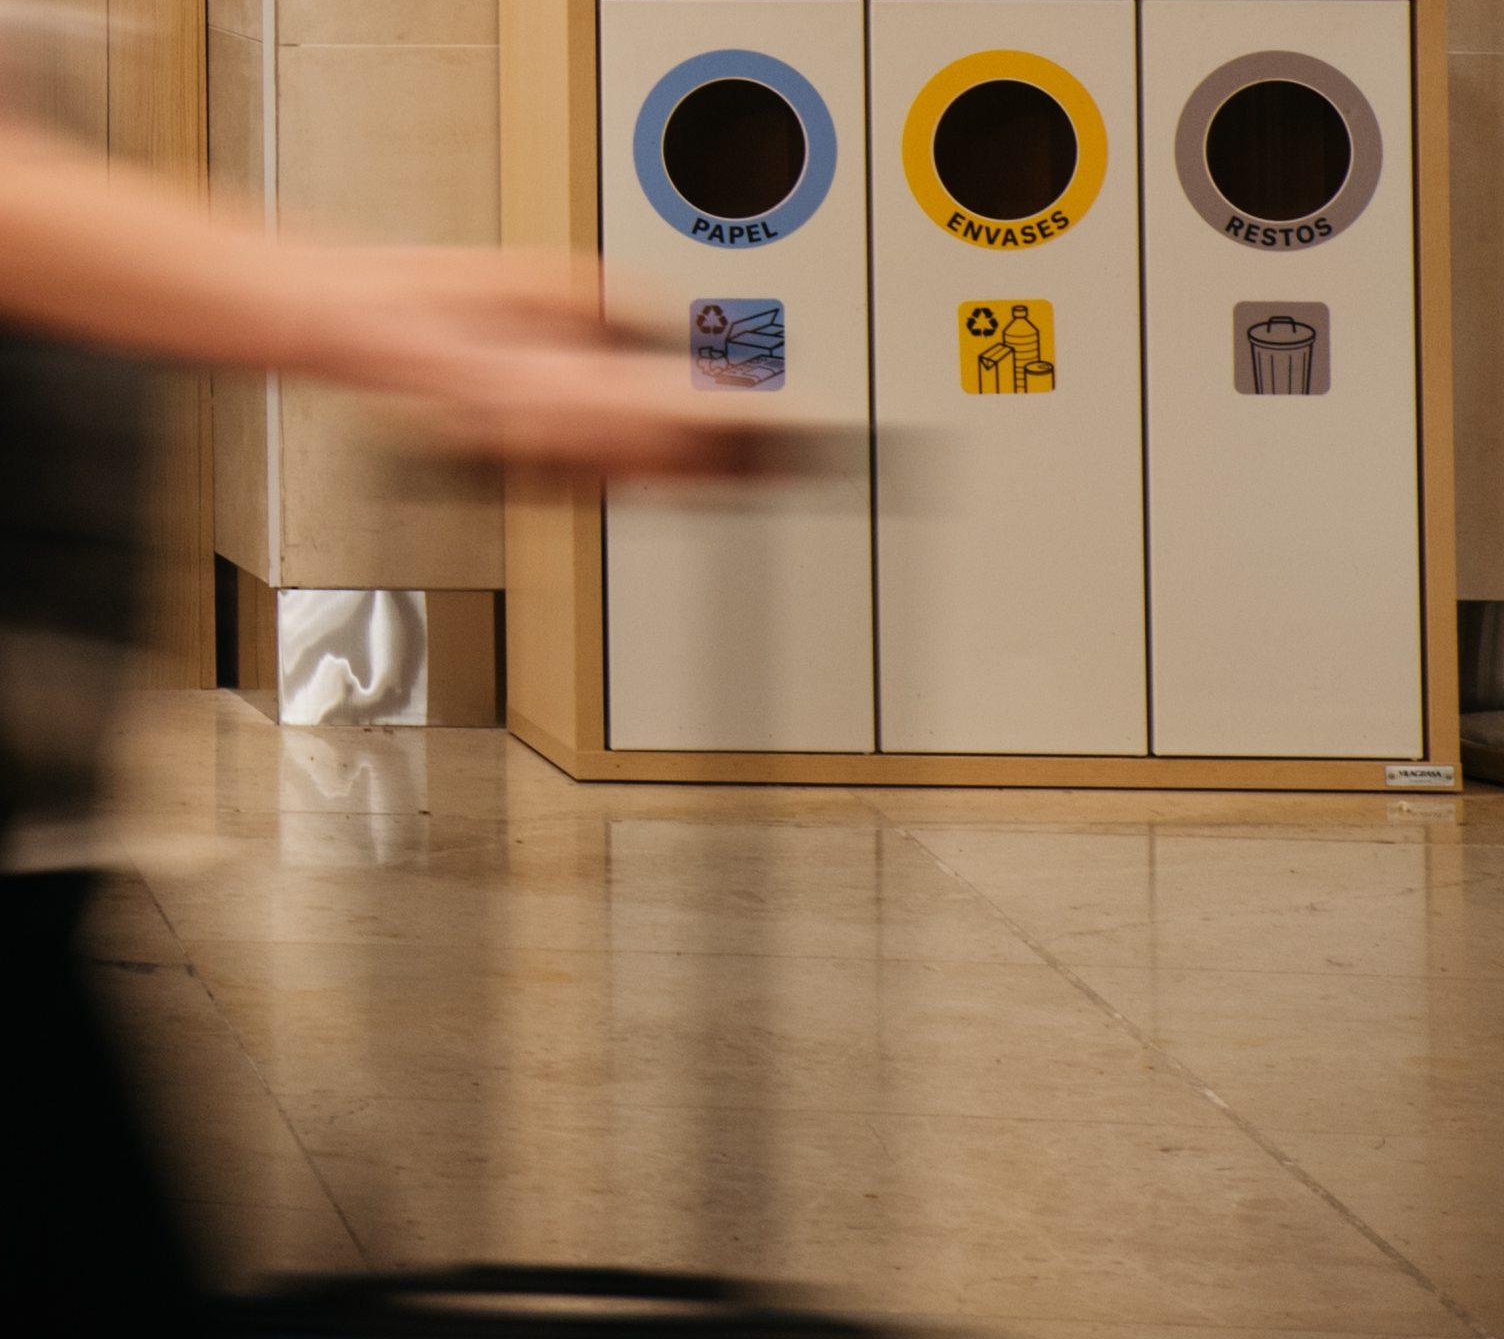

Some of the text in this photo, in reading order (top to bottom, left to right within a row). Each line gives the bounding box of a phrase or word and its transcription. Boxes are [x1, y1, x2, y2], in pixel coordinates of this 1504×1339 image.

[691, 216, 780, 245] PAPEL
[946, 210, 1070, 247] ENVASES
[1224, 215, 1334, 247] RESTOS
